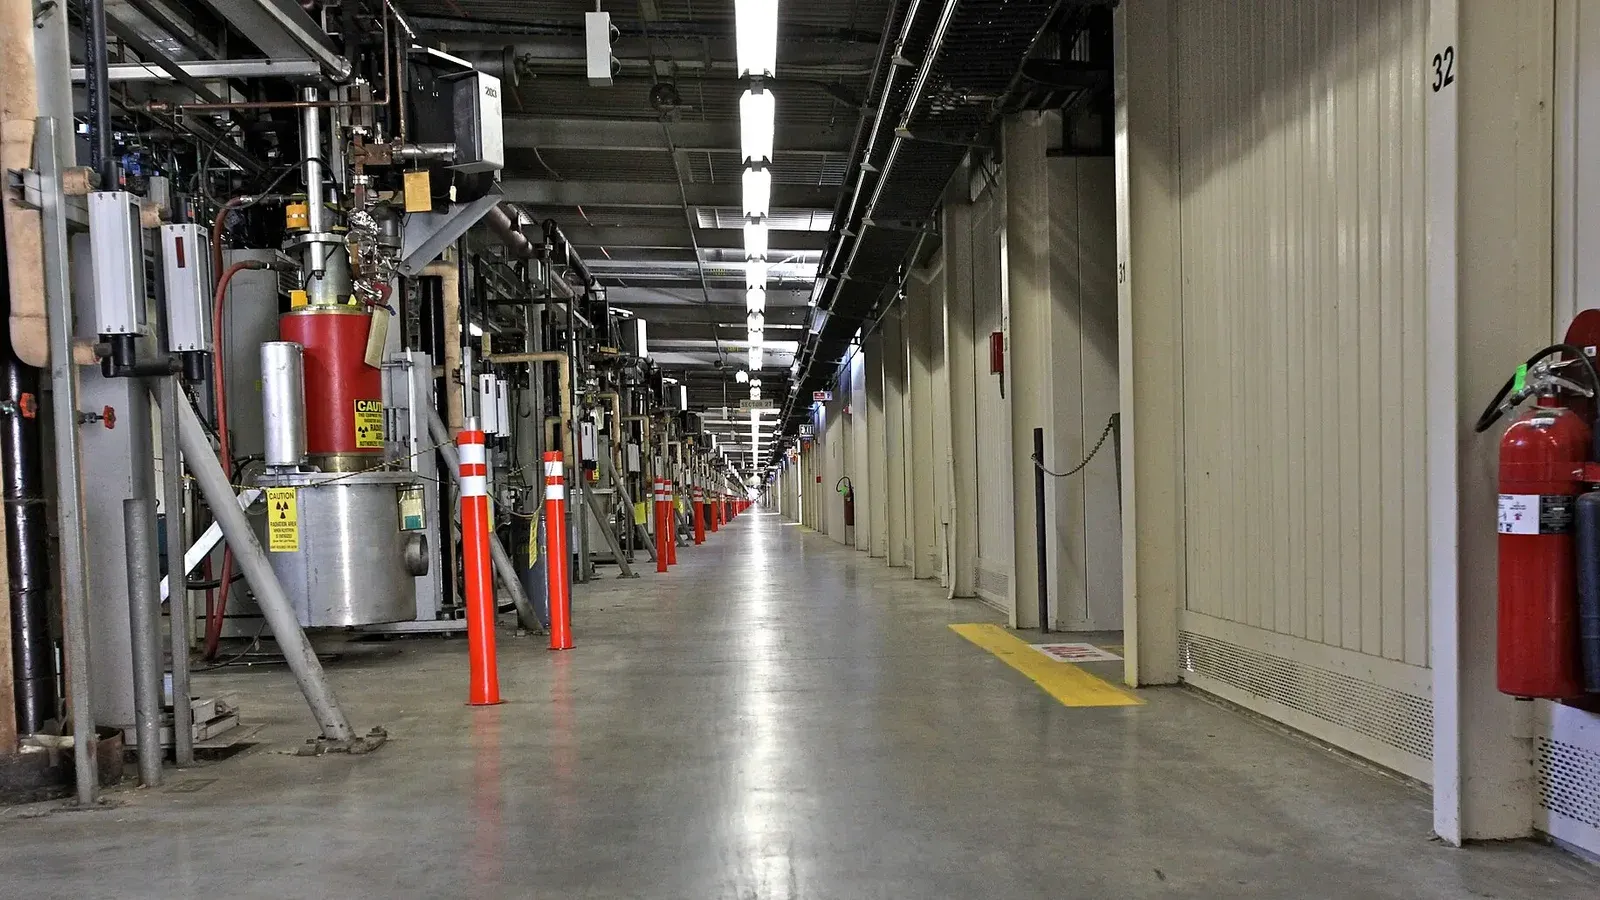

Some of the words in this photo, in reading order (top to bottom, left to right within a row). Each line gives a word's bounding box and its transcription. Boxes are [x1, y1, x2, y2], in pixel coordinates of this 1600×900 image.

[1433, 46, 1454, 92] 32
[1119, 261, 1126, 283] 31
[800, 425, 814, 434] EXIT
[269, 492, 295, 500] CAUTION
